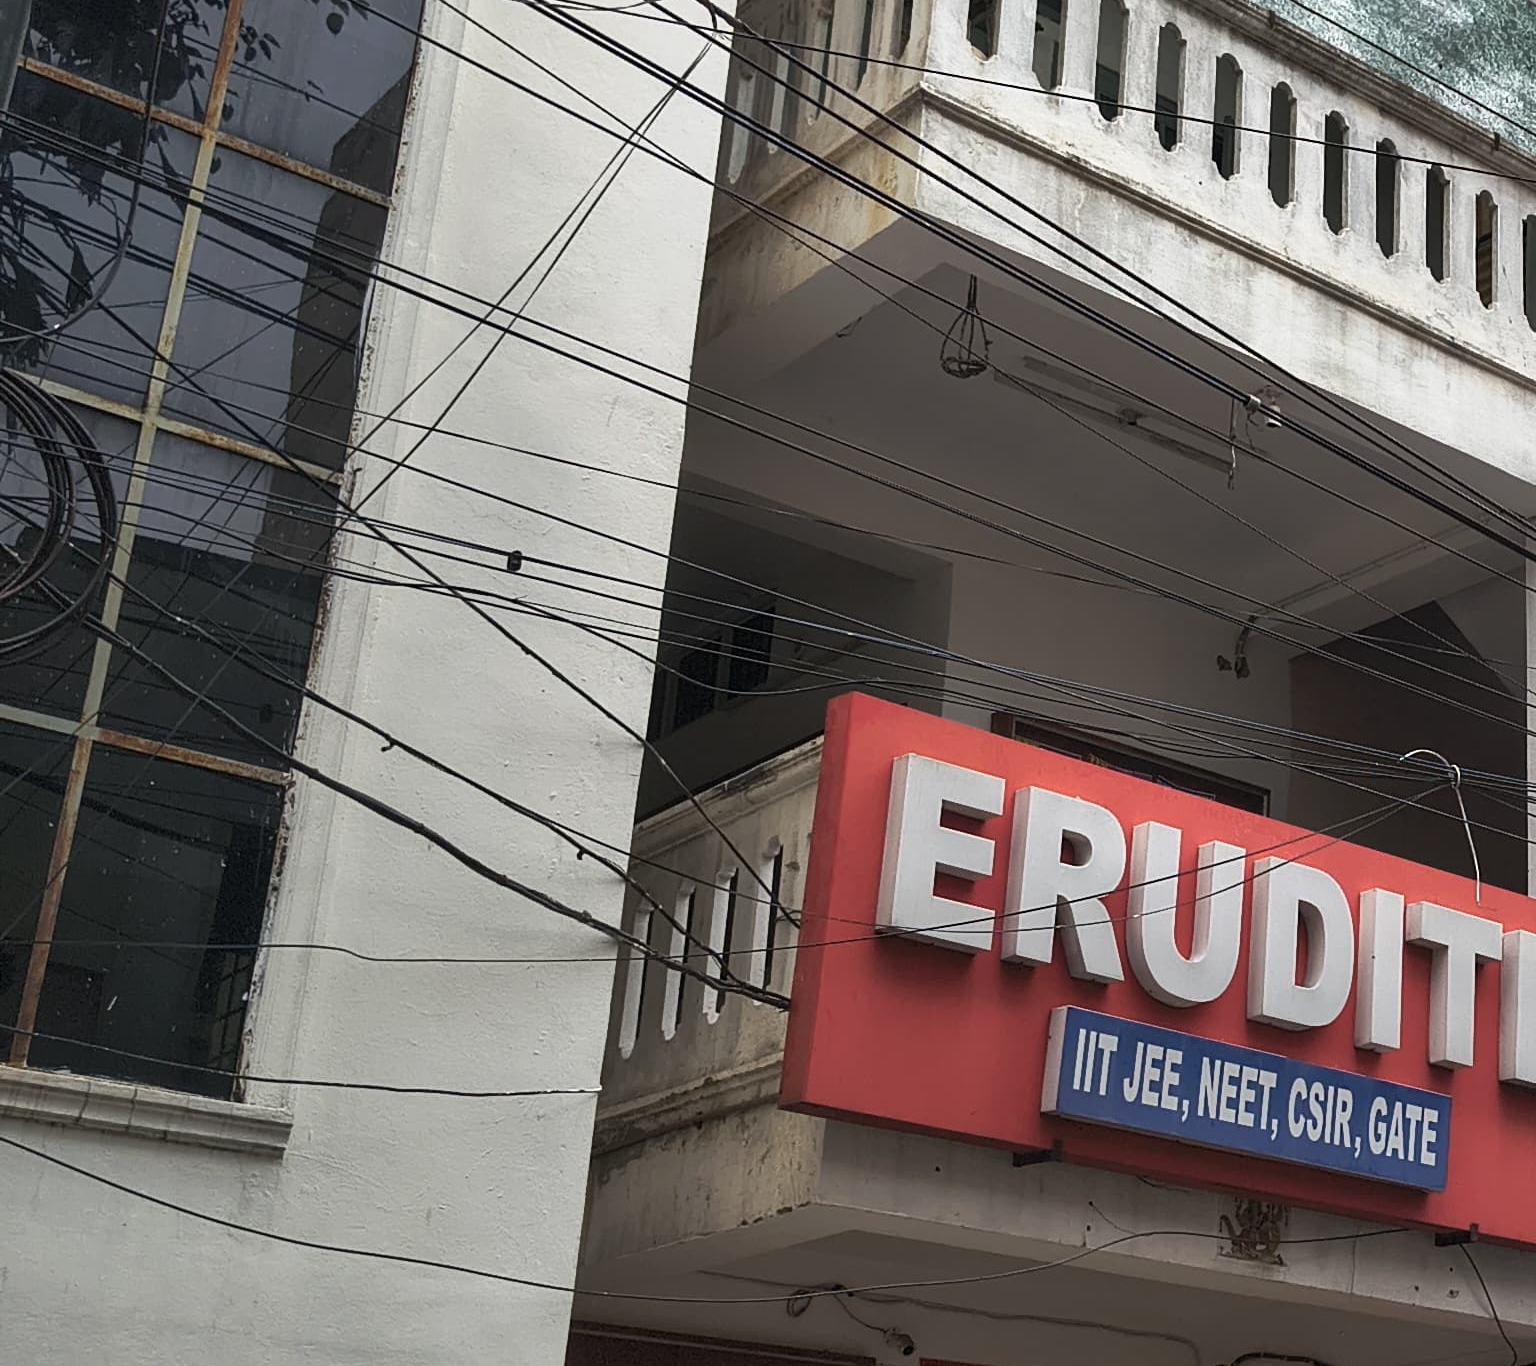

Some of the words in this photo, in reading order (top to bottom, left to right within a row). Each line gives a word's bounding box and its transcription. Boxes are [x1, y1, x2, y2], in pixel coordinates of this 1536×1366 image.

[1073, 1028, 1116, 1096] IIT
[1124, 1041, 1189, 1122] JEE,
[1198, 1058, 1278, 1141] NEET,
[1288, 1077, 1361, 1158] CSIR,
[1368, 1097, 1438, 1166] GATE
